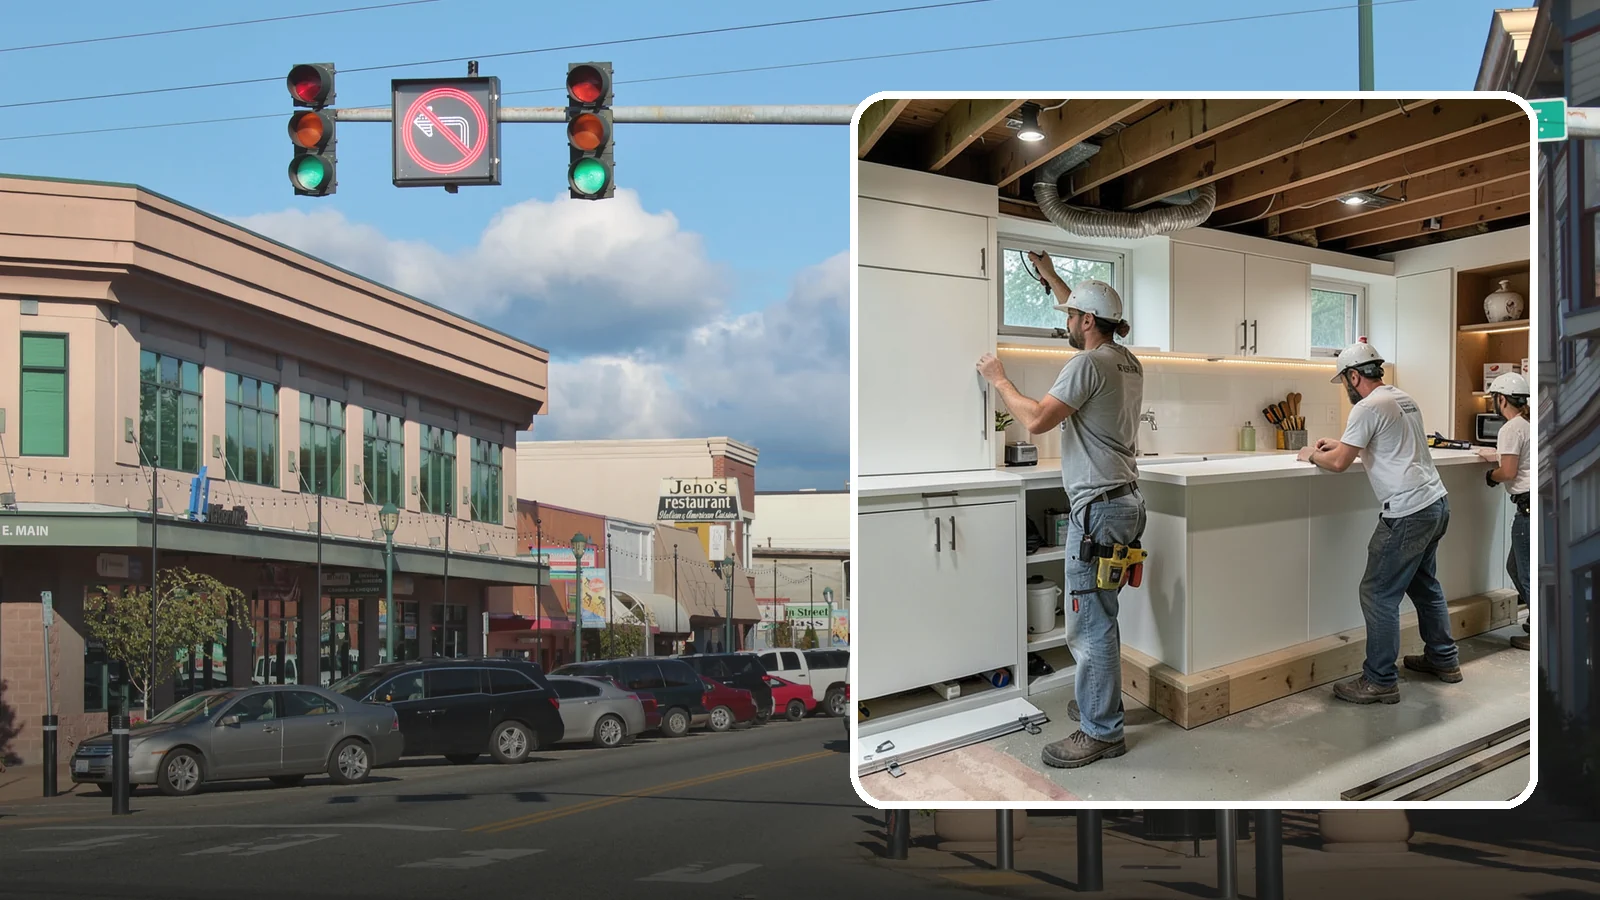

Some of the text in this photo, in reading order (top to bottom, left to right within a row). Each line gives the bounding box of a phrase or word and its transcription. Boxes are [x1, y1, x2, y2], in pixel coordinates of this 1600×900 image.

[669, 480, 728, 494] Jeno's
[665, 496, 731, 509] restaurant
[659, 510, 681, 519] Italian
[685, 510, 714, 519] American
[715, 510, 737, 519] Cuisine
[2, 525, 49, 536] E. MAIN
[797, 607, 828, 617] Street
